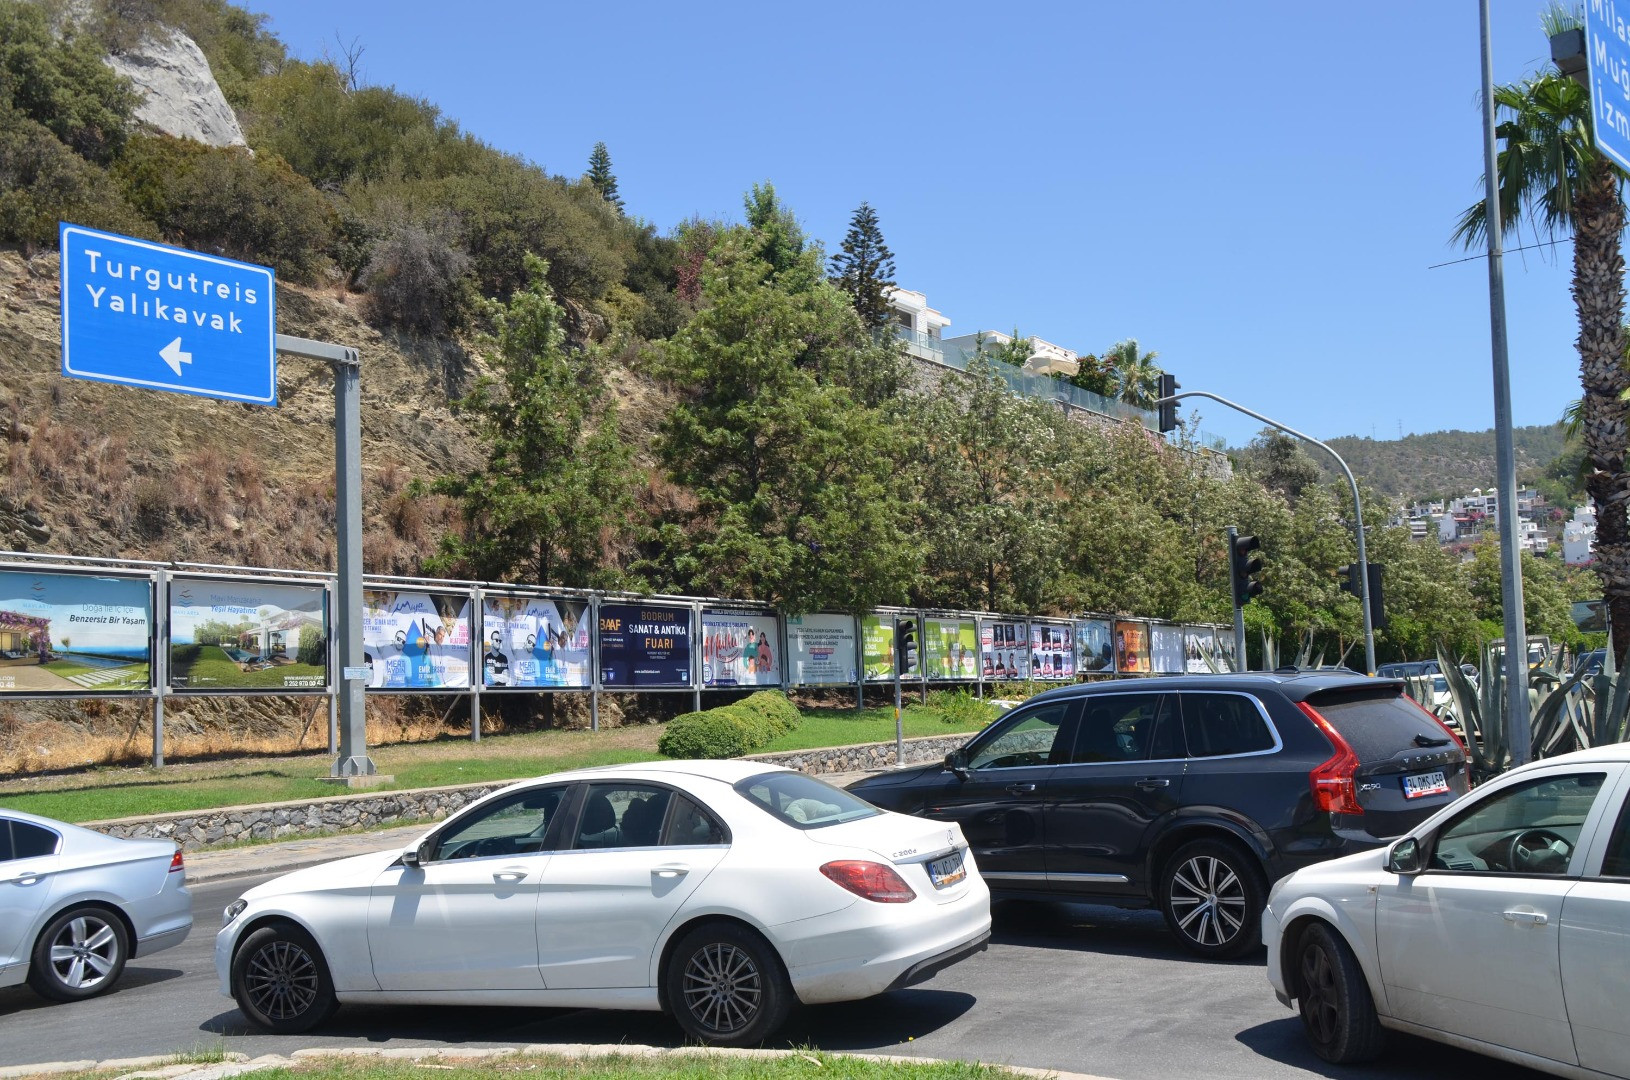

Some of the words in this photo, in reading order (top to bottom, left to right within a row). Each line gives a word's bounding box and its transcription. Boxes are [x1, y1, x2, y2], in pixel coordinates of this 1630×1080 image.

[84, 249, 257, 305] Turgutreis
[86, 284, 243, 334] Yalıkavak
[82, 603, 102, 614] Doğa
[210, 604, 226, 615] Yeşil
[227, 605, 257, 615] Hayatınız
[69, 614, 109, 625] Benzersiz
[109, 616, 121, 625] Bir
[122, 616, 146, 627] Yaşam
[641, 611, 674, 621] BODRUM
[628, 624, 653, 634] SANAT
[654, 625, 660, 634] &
[661, 623, 687, 635] ANTİKA
[645, 637, 674, 649] FUARI
[1360, 783, 1381, 791] XC90
[1407, 777, 1417, 792] 34
